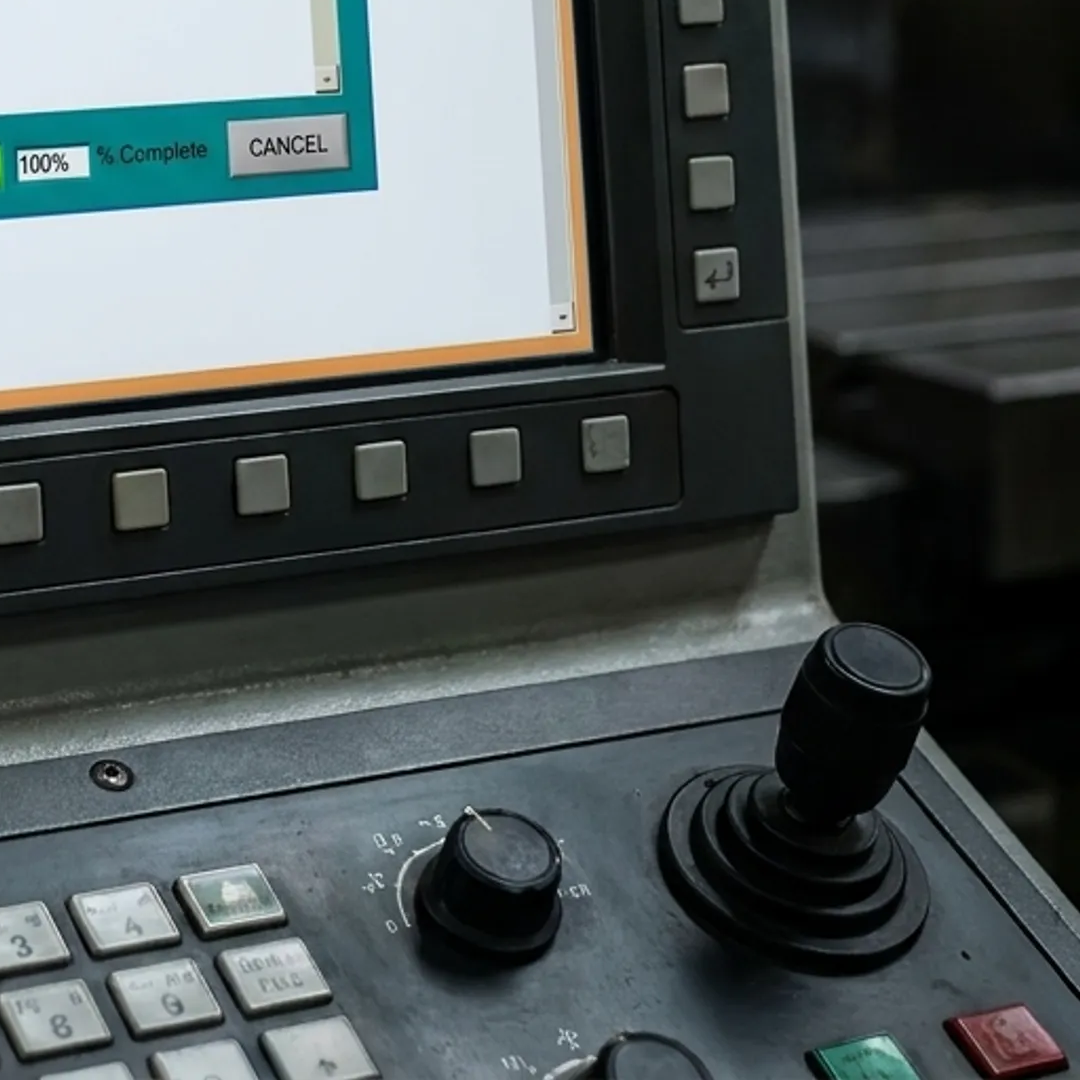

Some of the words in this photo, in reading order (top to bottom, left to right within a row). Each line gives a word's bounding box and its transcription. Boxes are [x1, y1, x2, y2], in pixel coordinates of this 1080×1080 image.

[19, 153, 69, 175] 100%
[120, 141, 208, 165] Complete
[249, 134, 328, 158] CANCEL
[11, 934, 33, 958] 3
